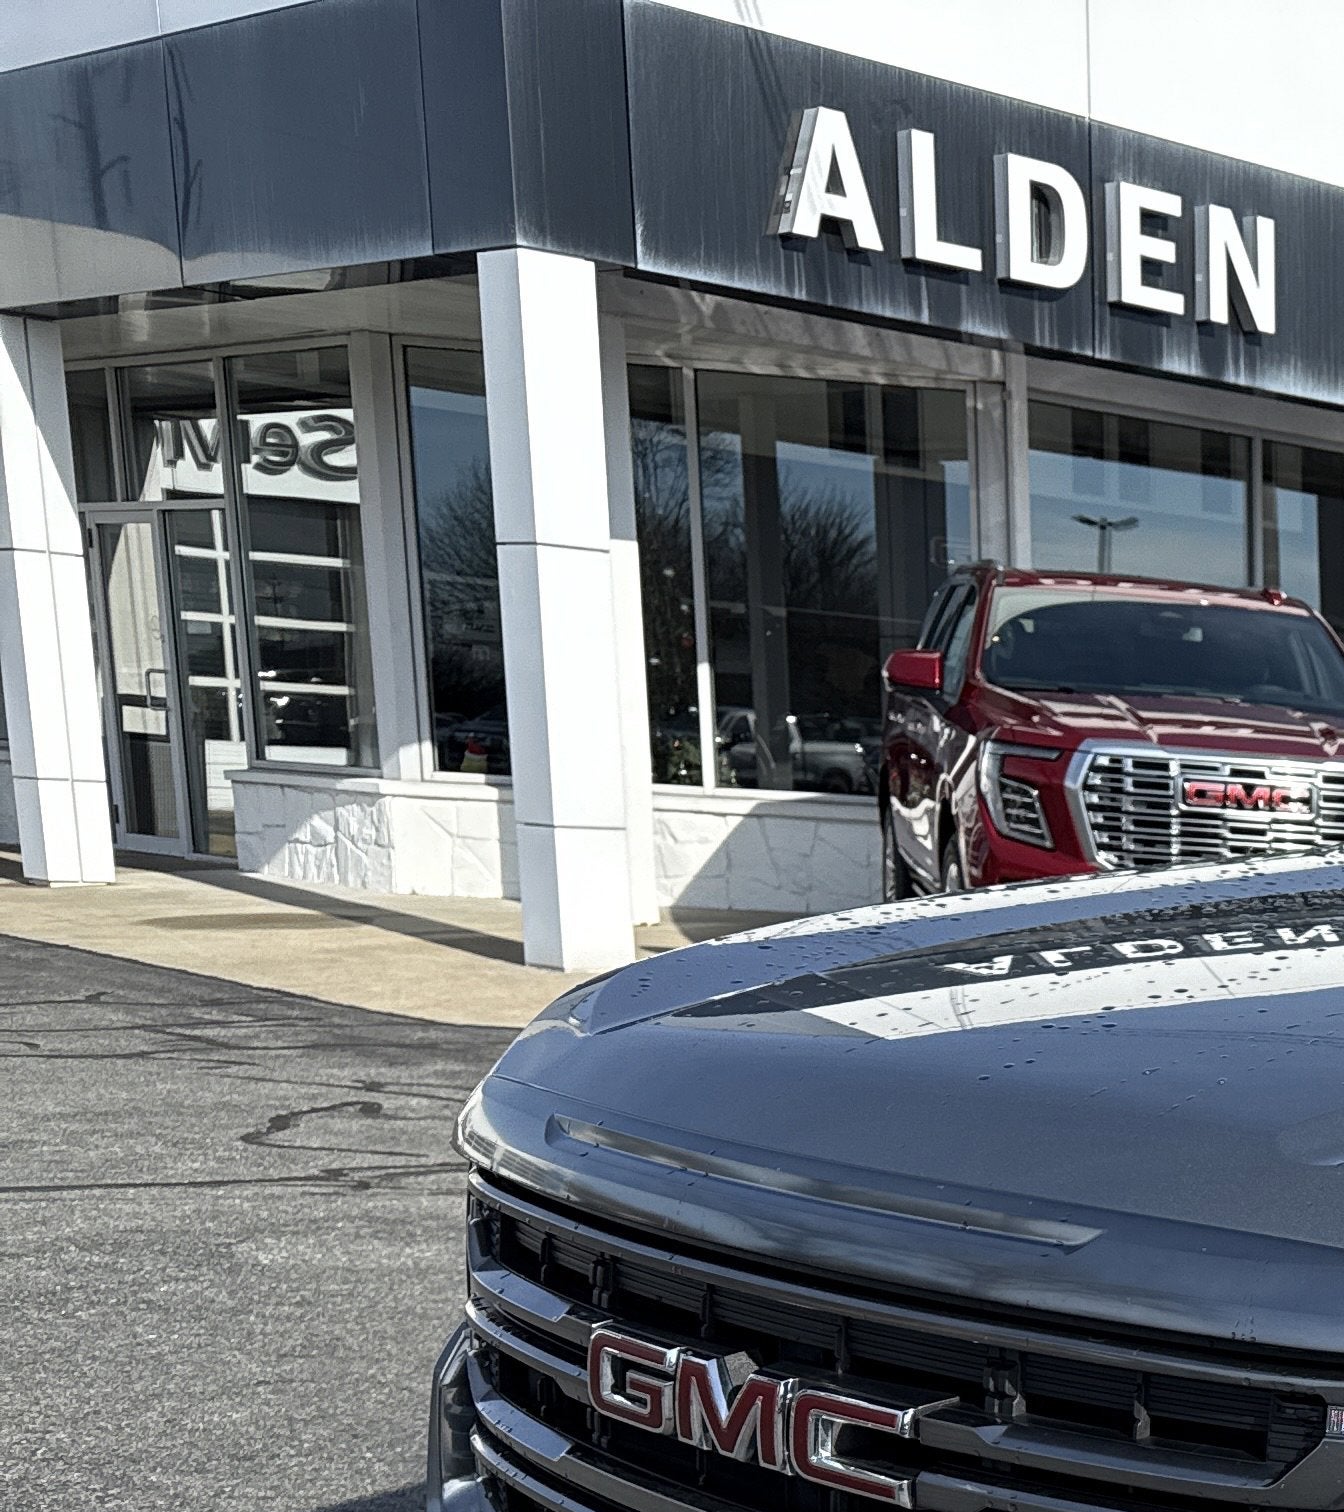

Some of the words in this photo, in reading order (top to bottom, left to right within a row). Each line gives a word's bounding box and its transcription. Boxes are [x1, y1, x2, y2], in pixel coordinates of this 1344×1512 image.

[780, 106, 1277, 334] ALDEN
[1184, 781, 1310, 813] GMC
[587, 1329, 914, 1509] GMC
